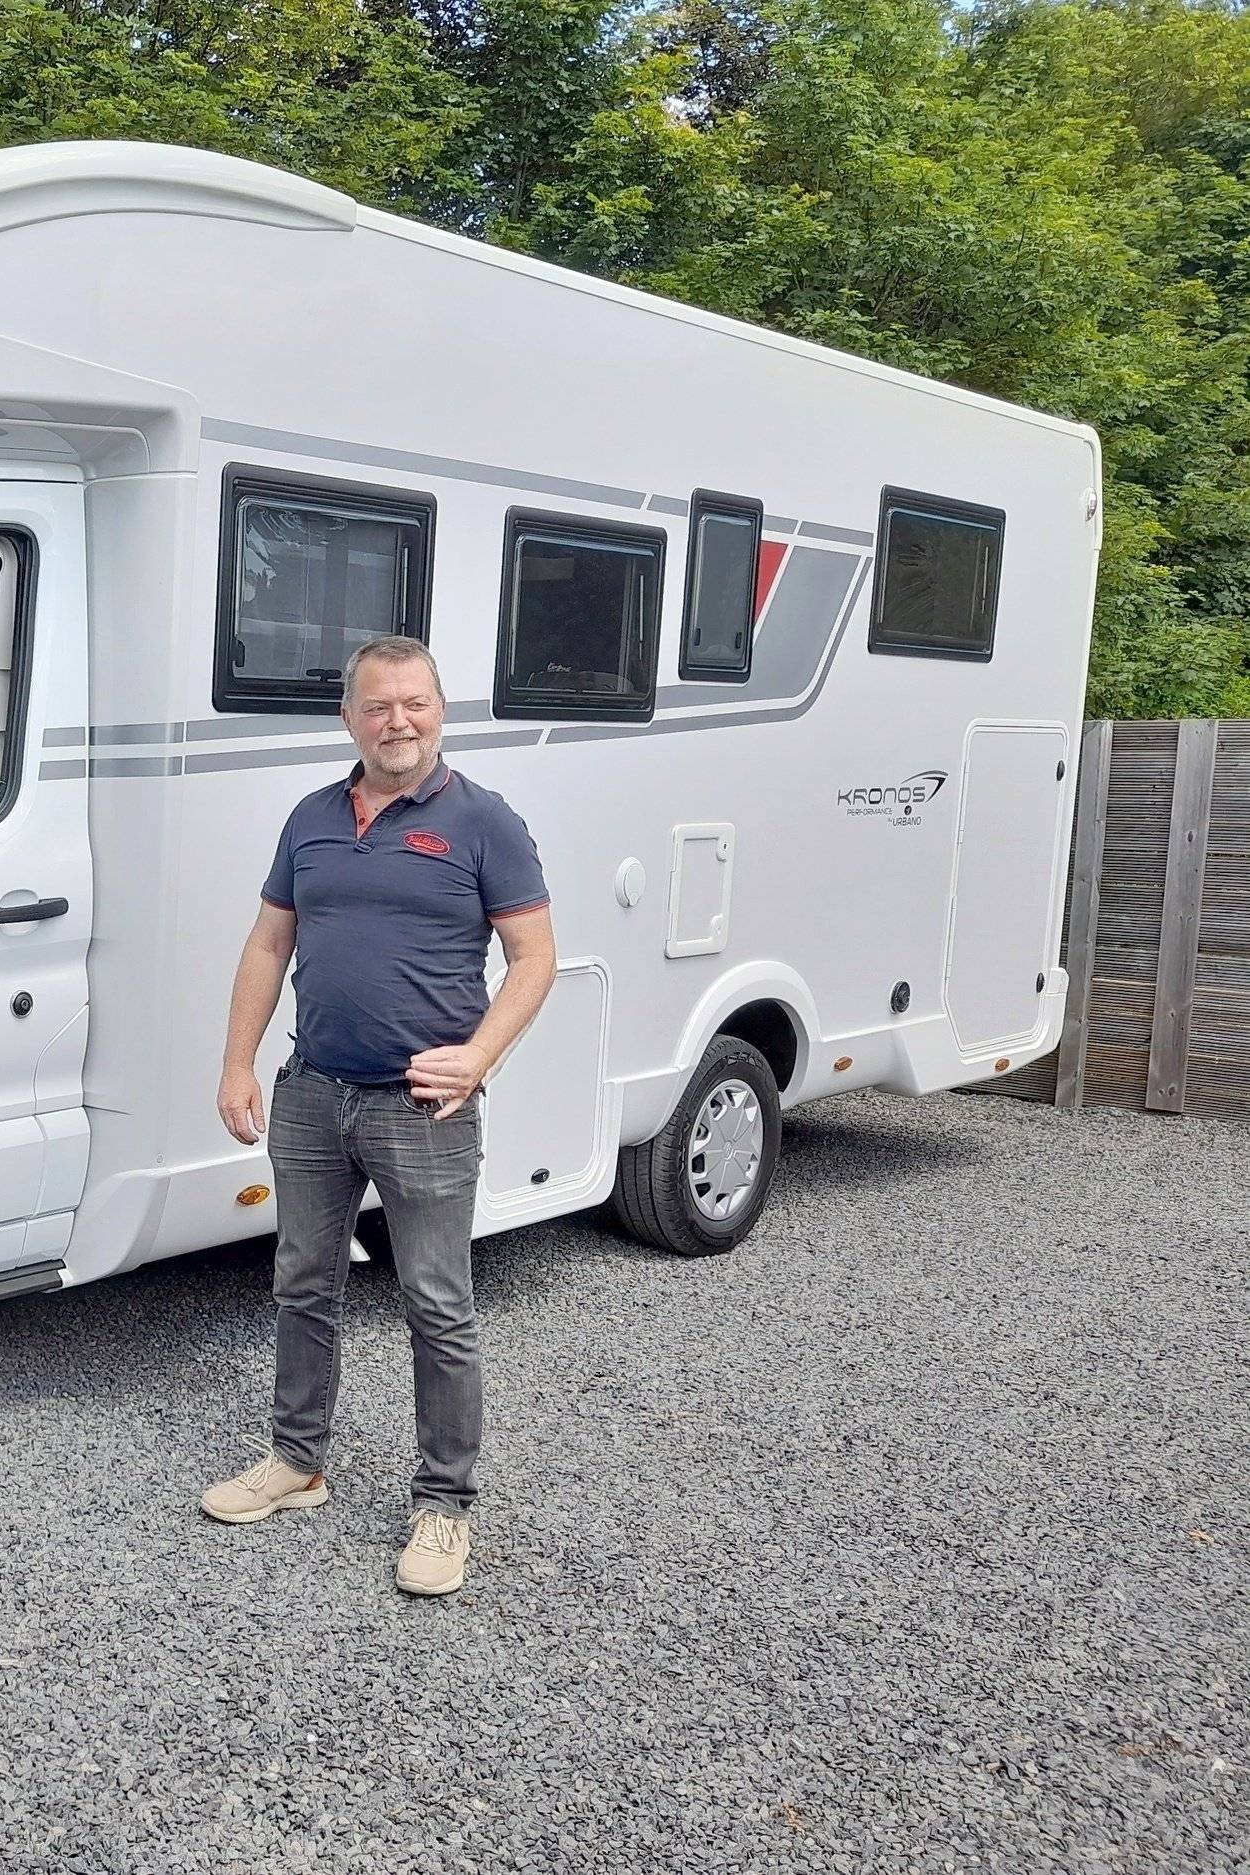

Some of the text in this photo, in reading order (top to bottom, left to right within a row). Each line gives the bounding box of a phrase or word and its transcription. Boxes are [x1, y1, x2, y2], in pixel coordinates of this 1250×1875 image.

[837, 786, 925, 805] KRONOS
[846, 807, 893, 816] PERFORMANCE
[892, 816, 922, 827] URBANO
